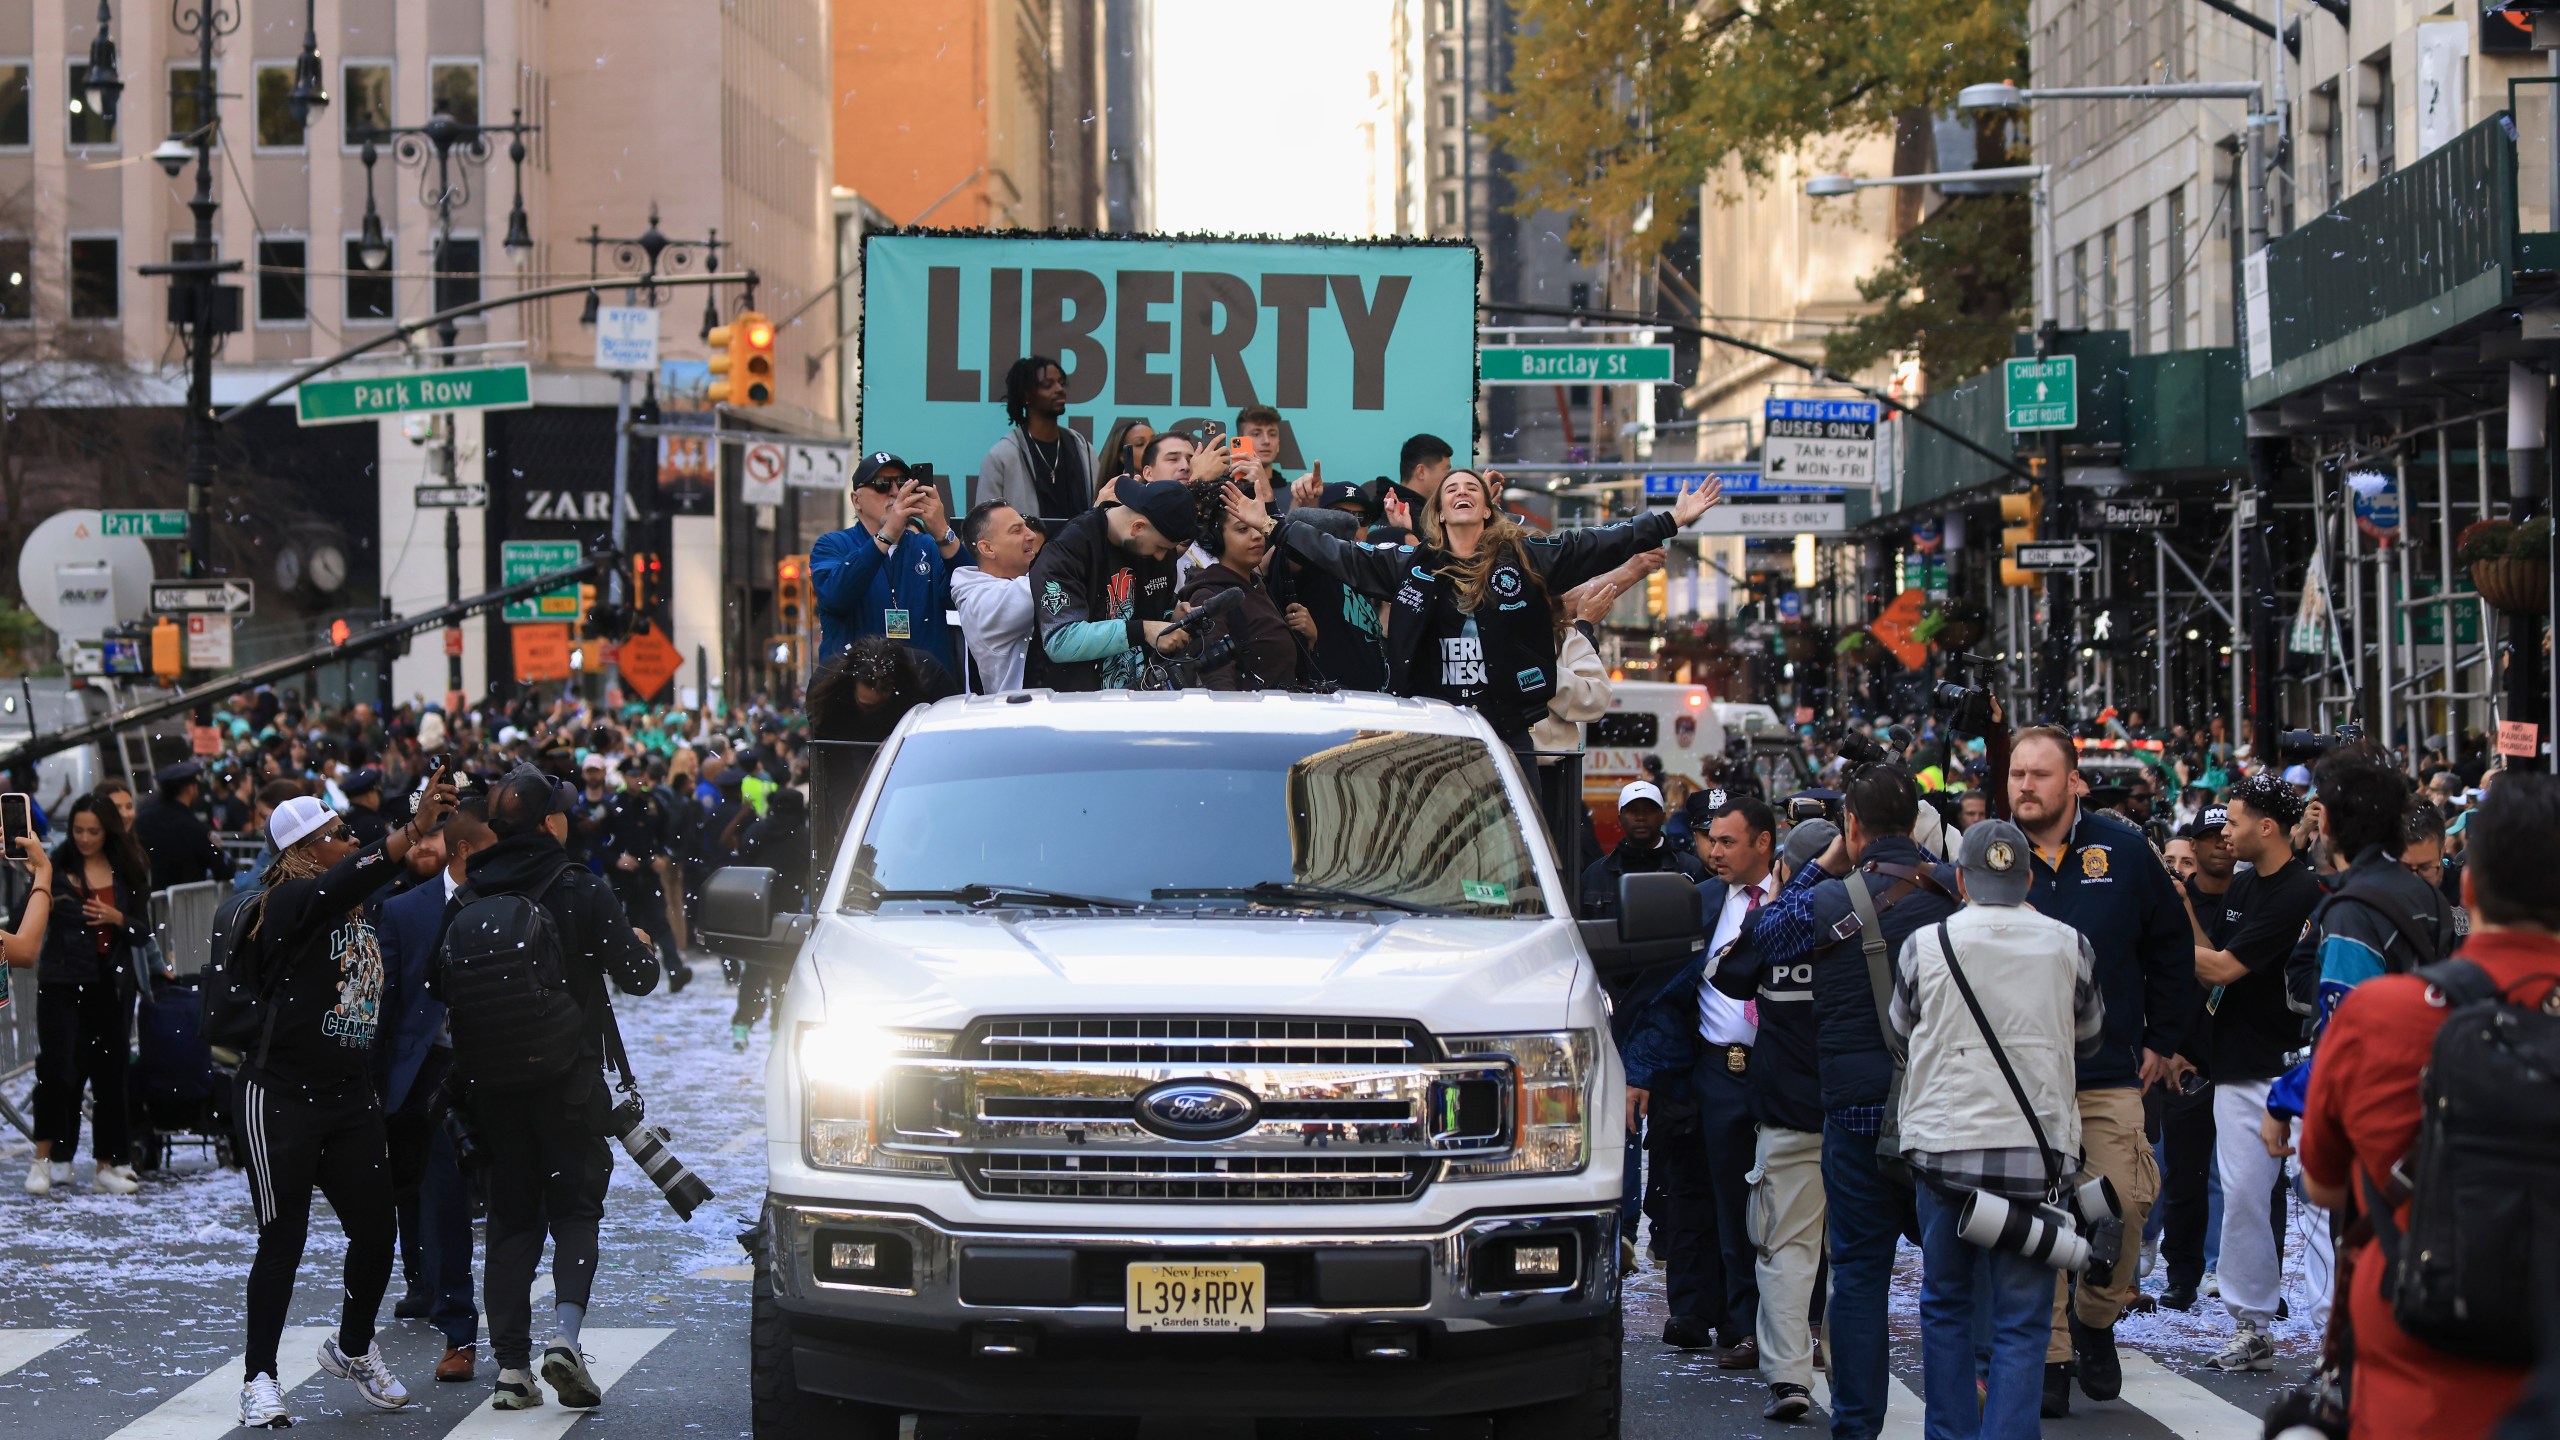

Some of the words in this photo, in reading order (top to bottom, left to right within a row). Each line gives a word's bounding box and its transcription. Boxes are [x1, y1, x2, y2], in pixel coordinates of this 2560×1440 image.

[925, 265, 1413, 411] LIBERTY
[1522, 353, 1600, 379] Barclay
[1607, 353, 1628, 375] St
[2014, 363, 2054, 379] CHURCH
[2056, 363, 2068, 376] ST
[354, 382, 411, 410] Park
[420, 380, 473, 404] Row
[1791, 402, 1825, 418] BUS
[1829, 403, 1872, 420] LANE
[2017, 408, 2039, 424] BEST
[2040, 406, 2067, 422] ROUTE
[1770, 420, 1823, 437] BUSES
[1828, 422, 1870, 439] ONLY
[105, 514, 154, 535] Park
[1741, 513, 1788, 526] BUSES
[1793, 512, 1830, 525] ONLY
[2106, 505, 2162, 527] Barclay
[2028, 550, 2050, 561] ONE
[2063, 549, 2087, 561] WAY
[158, 591, 186, 604] ONE
[205, 590, 237, 603] WAY
[1168, 1095, 1227, 1120] Ford
[1161, 1266, 1191, 1278] New
[1191, 1266, 1230, 1280] Jersey
[1136, 1280, 1187, 1315] L39
[1205, 1280, 1255, 1315] RPX
[1161, 1317, 1199, 1328] Garden
[1202, 1317, 1231, 1328] State
